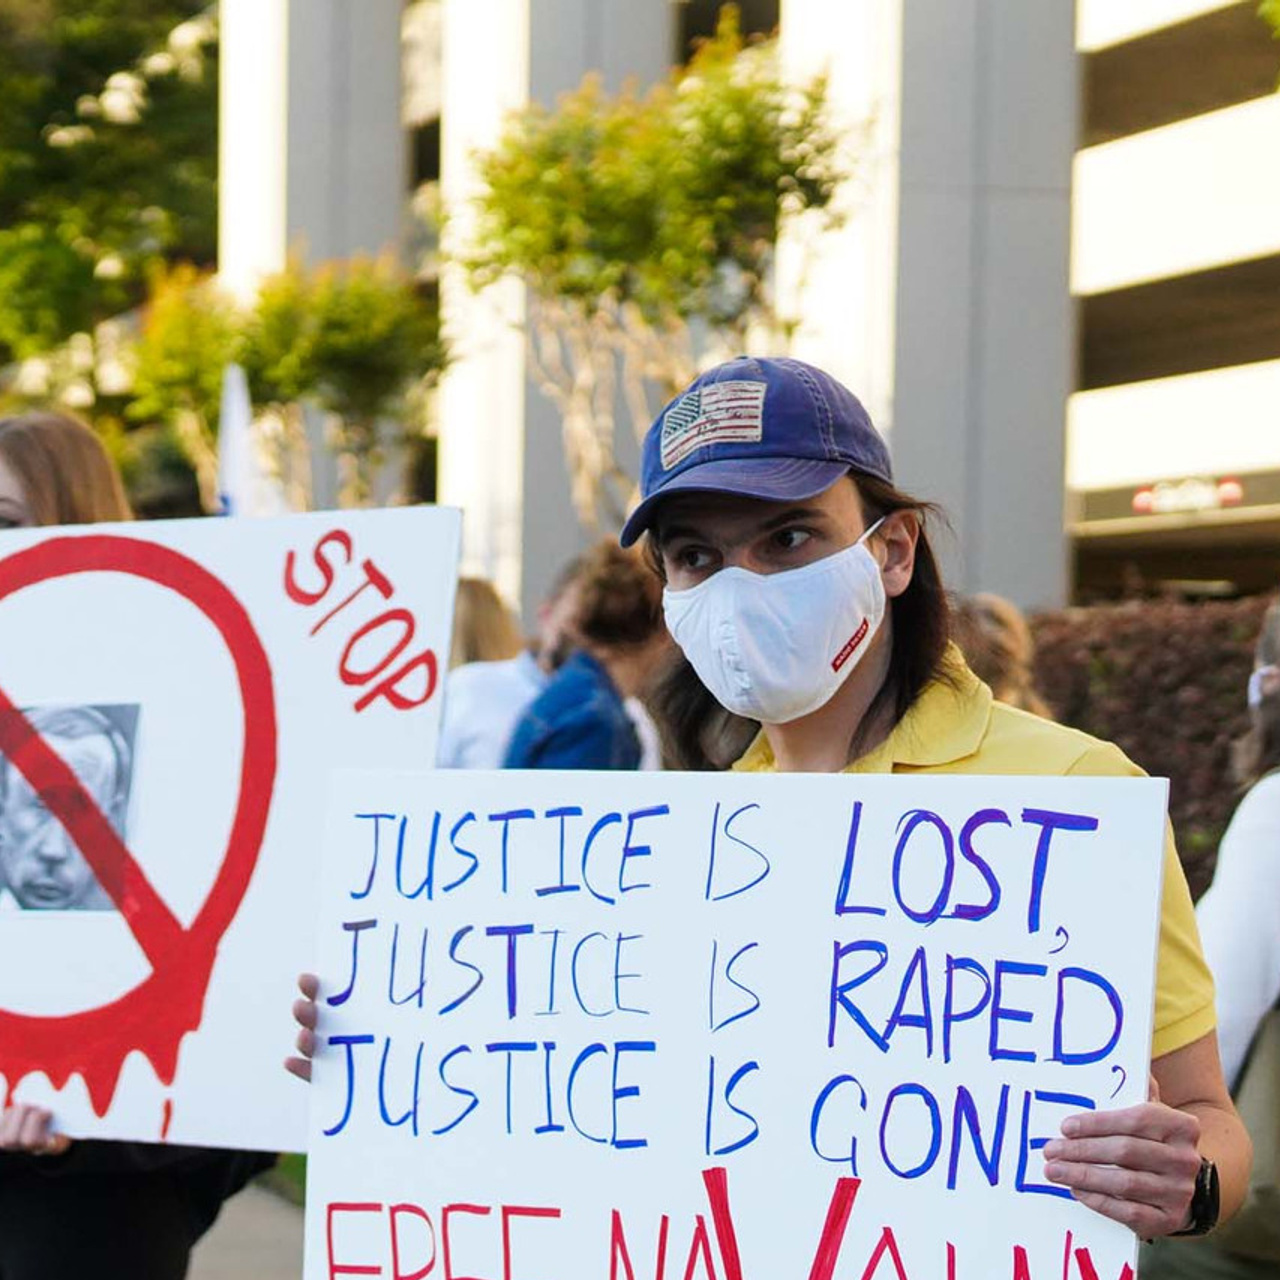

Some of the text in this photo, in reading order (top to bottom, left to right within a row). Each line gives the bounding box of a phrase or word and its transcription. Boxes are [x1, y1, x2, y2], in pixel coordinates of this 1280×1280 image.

[283, 529, 438, 713] STOP
[350, 800, 1099, 956] JUSTICE IS LOST,
[326, 921, 1126, 1099] JUSTICE IS RAPED,
[322, 1033, 1096, 1201] JUSTICE IS GONE
